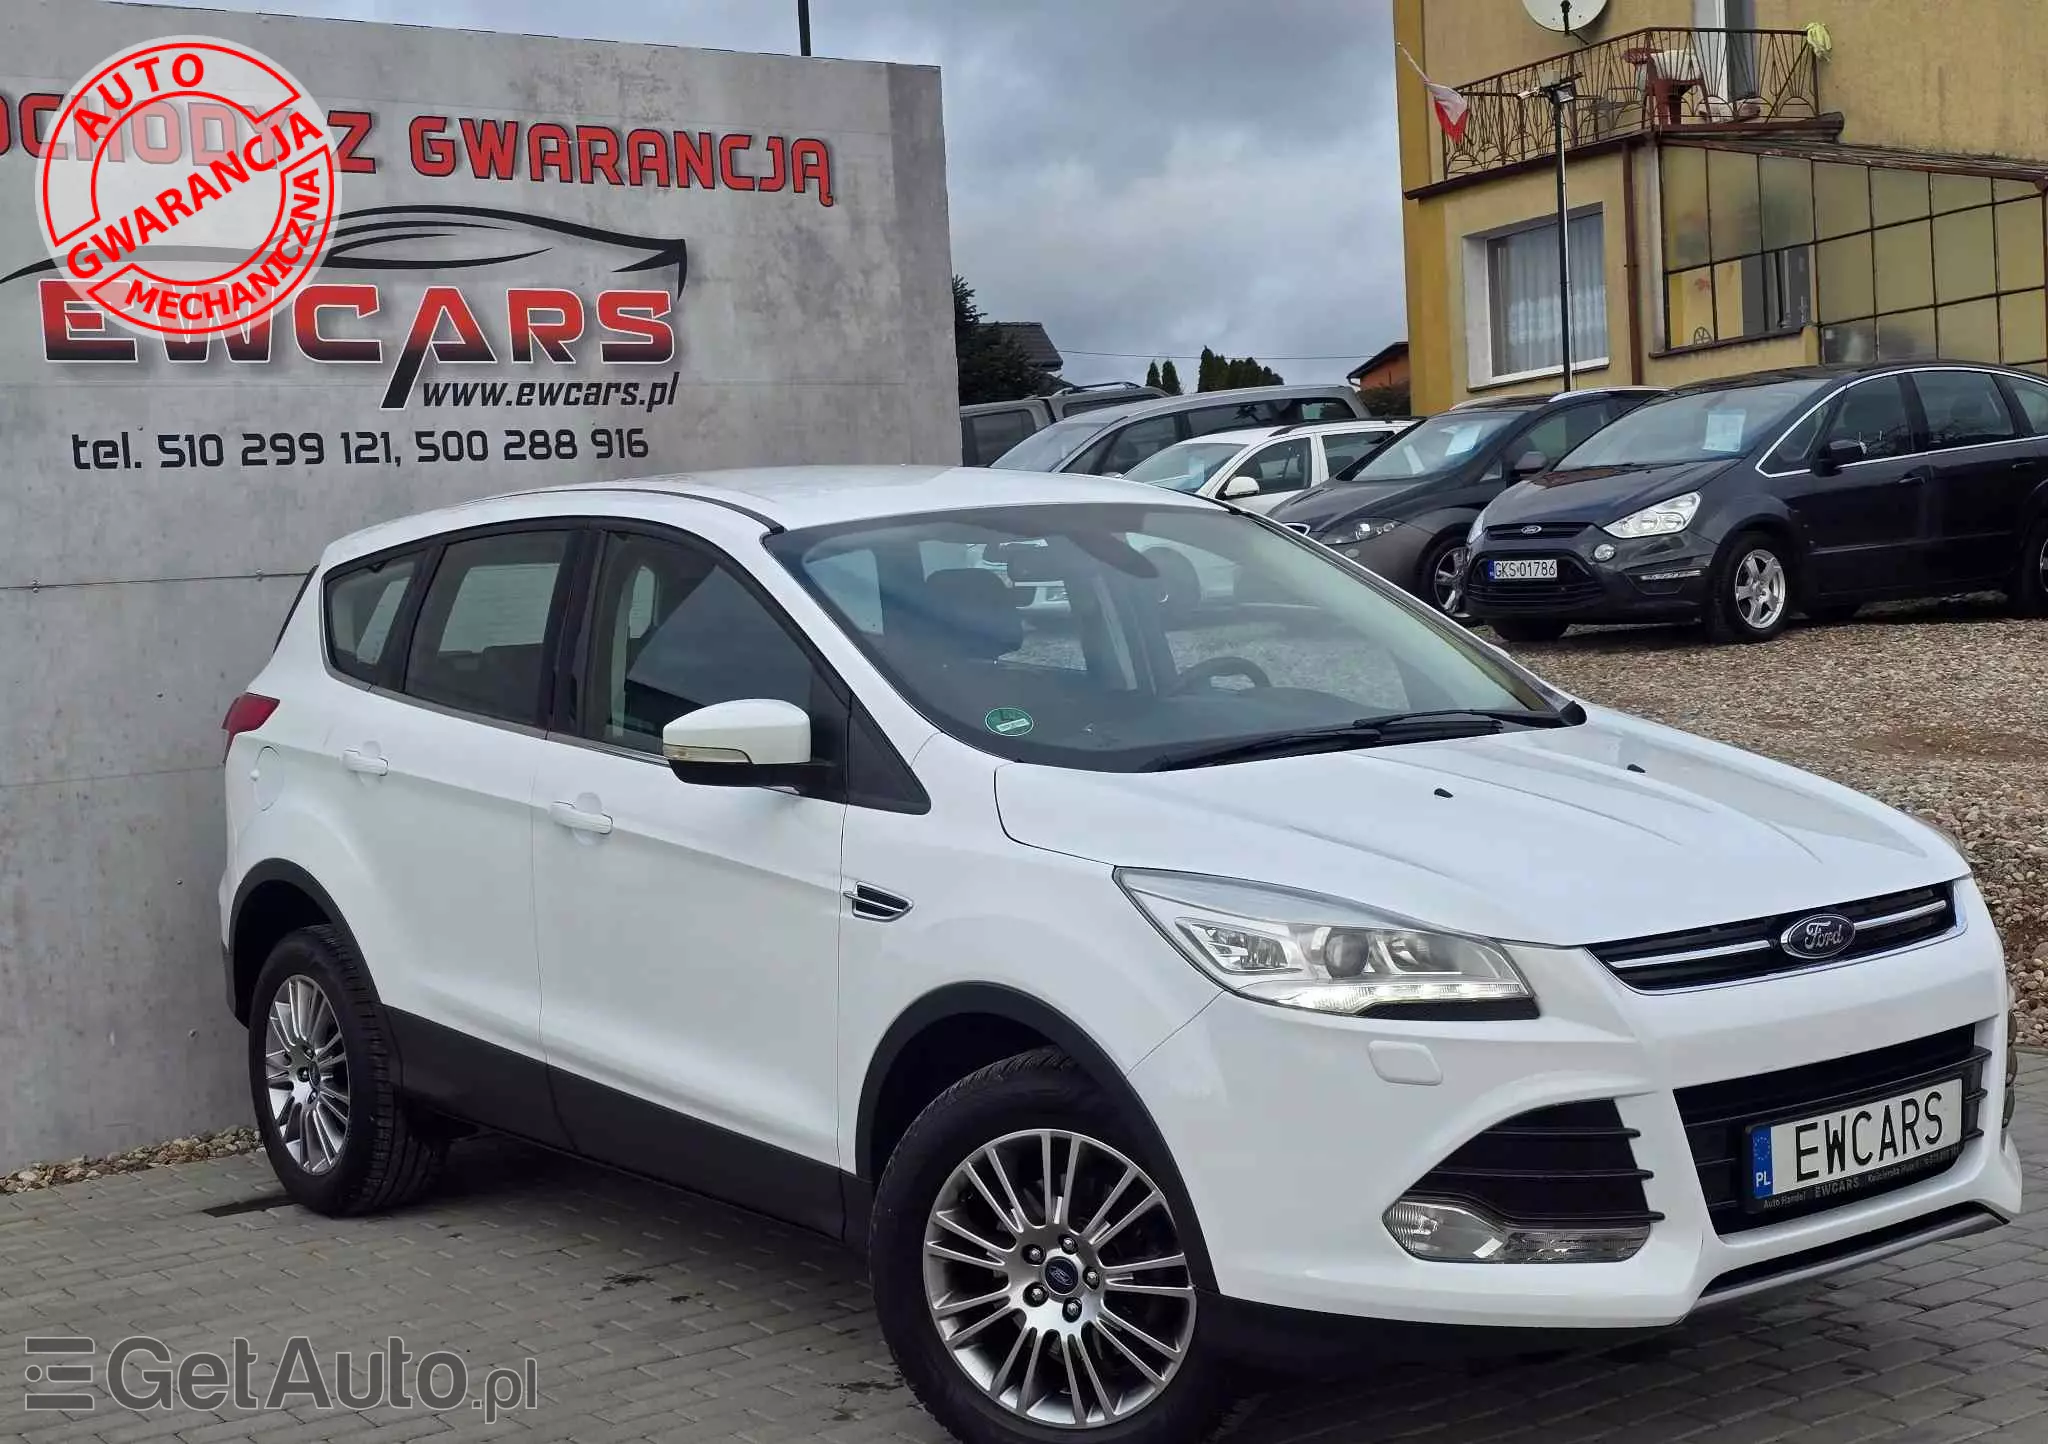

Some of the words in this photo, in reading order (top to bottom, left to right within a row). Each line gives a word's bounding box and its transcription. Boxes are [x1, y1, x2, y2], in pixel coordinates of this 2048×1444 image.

[0, 92, 293, 169] CHODY
[326, 109, 377, 174] Z
[408, 115, 834, 207] GWARANCJĄ
[39, 279, 675, 411] EWCARS
[422, 371, 680, 413] www.ewcars.pl
[72, 432, 143, 470] tel.
[158, 431, 225, 468] 510
[241, 431, 325, 467] 299
[341, 430, 402, 468] 121,
[415, 429, 489, 465] 500
[502, 428, 579, 462] 288
[593, 427, 650, 459] 916
[1804, 920, 1843, 949] Ford
[1794, 1091, 1943, 1183] EWCARS
[1755, 1170, 1772, 1188] PL
[1815, 1176, 1860, 1199] EWCARS
